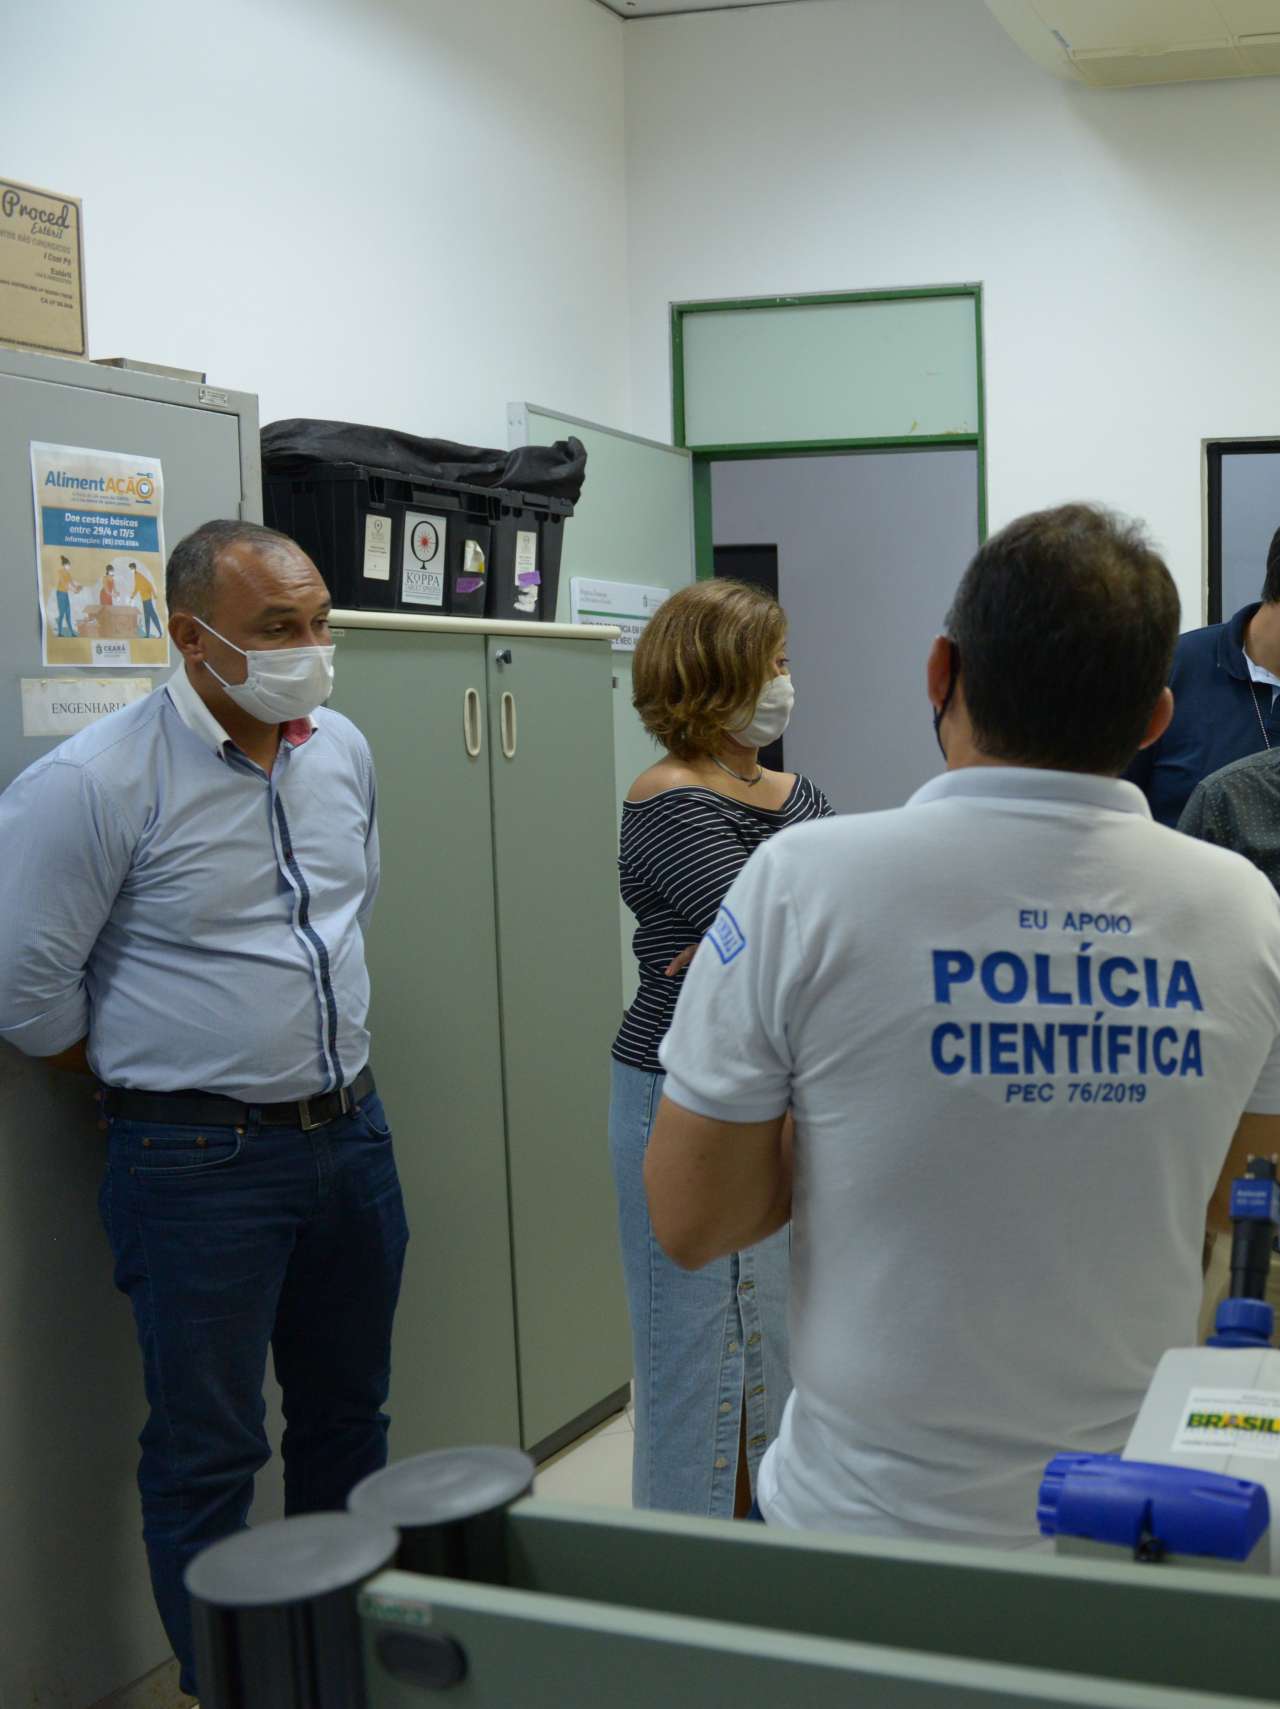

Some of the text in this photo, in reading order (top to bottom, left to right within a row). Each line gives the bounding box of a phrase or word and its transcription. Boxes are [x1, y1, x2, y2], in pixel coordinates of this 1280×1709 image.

[2, 190, 70, 229] Proced
[69, 526, 92, 535] entre
[81, 515, 109, 526] cestas
[52, 702, 126, 715] ENGENHARI
[1019, 909, 1132, 934] EU APOIO
[931, 942, 1204, 1011] POLÍCIA
[930, 1011, 1204, 1077] CIENTÍFICA
[1005, 1083, 1147, 1104] PEC 76/2019
